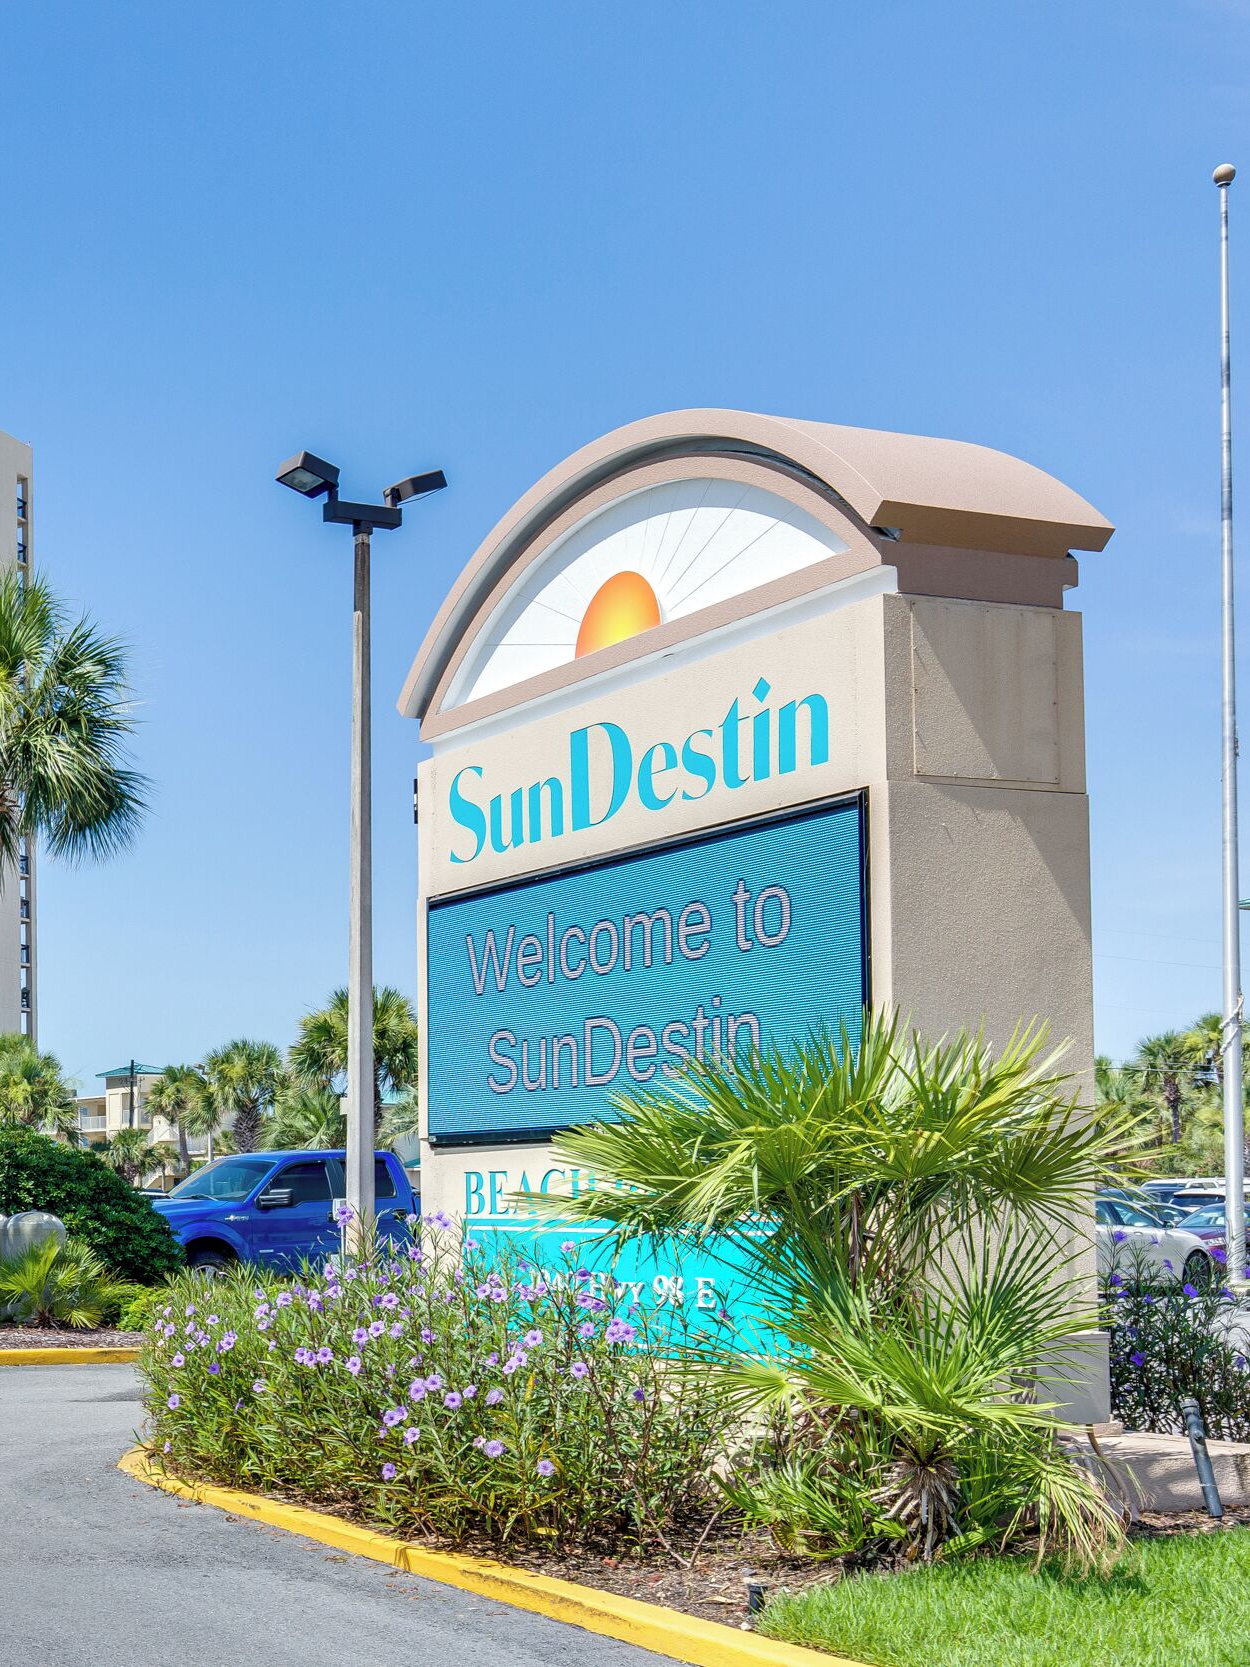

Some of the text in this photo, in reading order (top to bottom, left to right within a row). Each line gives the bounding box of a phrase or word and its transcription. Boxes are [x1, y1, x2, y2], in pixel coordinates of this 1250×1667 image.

[449, 677, 830, 865] SunDestin
[466, 879, 791, 995] Welcome to
[488, 996, 762, 1095] SunDestin
[695, 1277, 717, 1308] E
